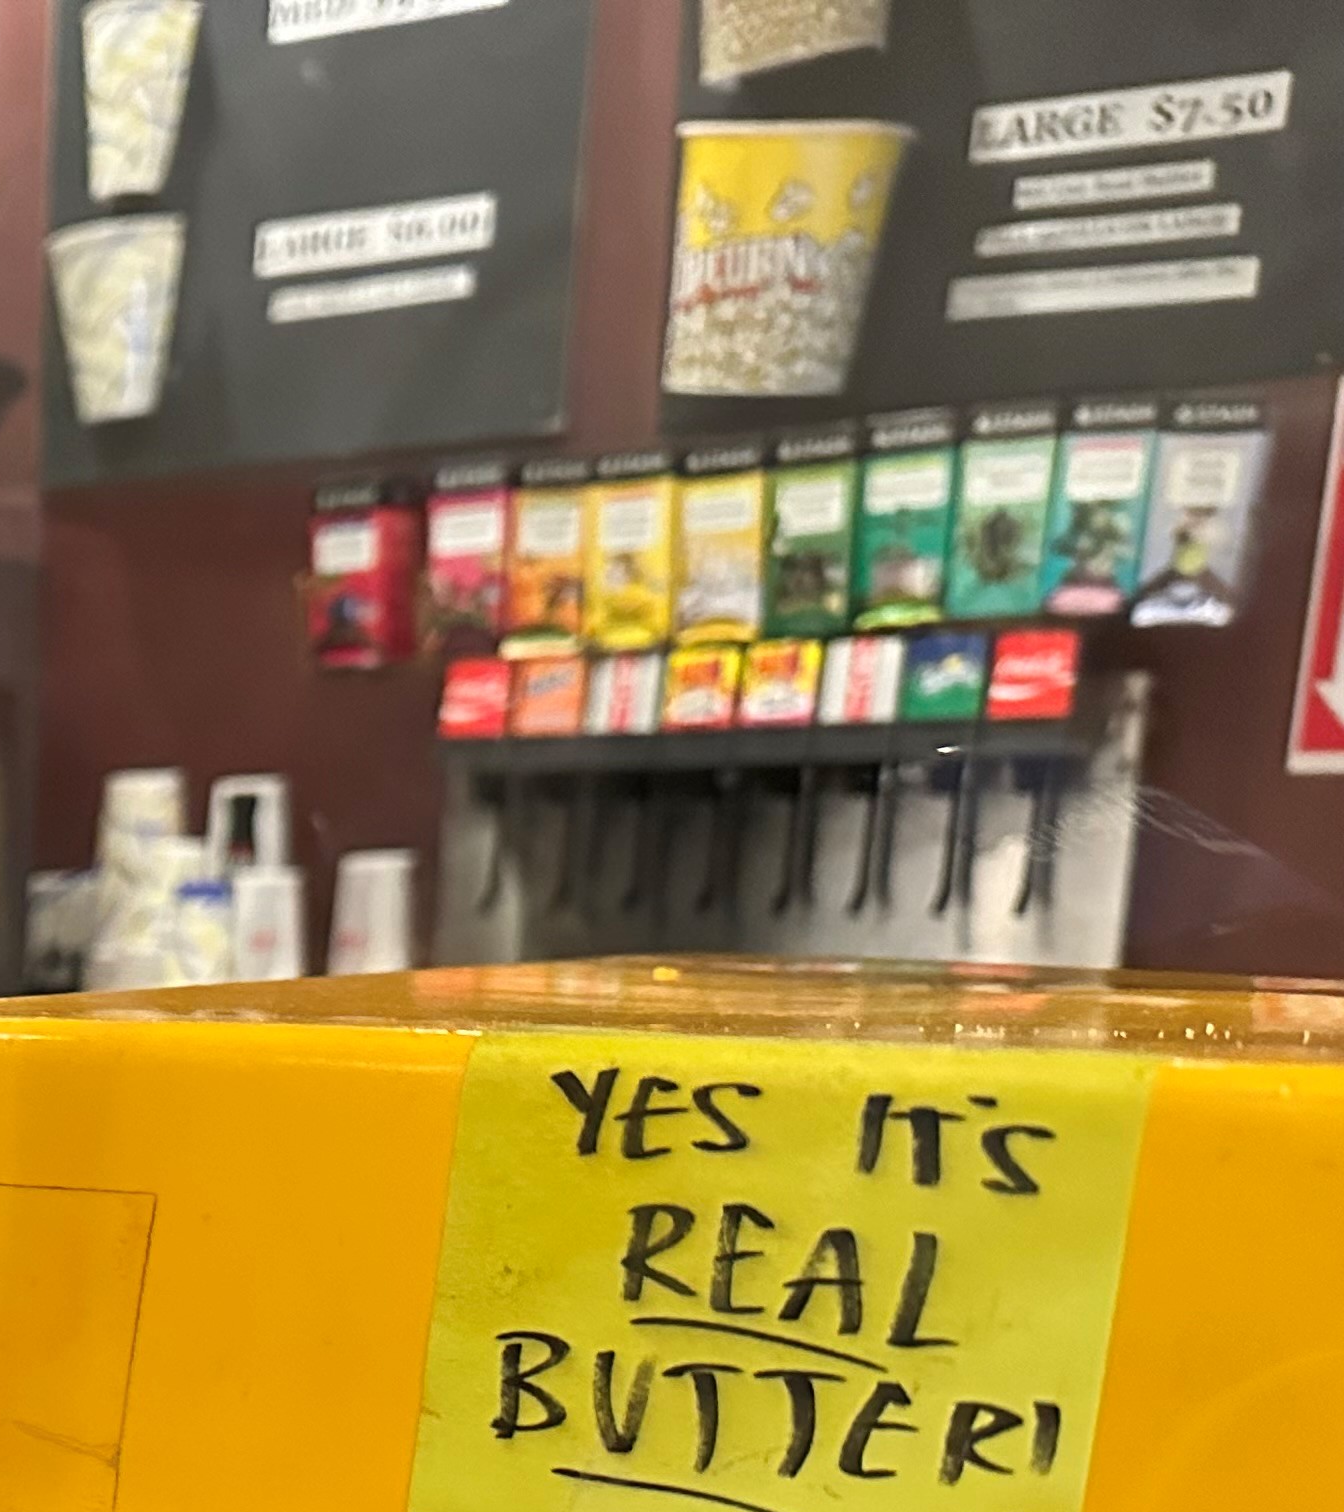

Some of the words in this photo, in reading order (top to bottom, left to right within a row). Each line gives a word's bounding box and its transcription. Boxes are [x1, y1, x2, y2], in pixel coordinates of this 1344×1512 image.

[976, 103, 1123, 149] LARGE
[1147, 89, 1274, 134] $7.50
[551, 1067, 762, 1160] YES
[855, 1092, 1056, 1195] IT'S
[621, 1203, 959, 1348] REAL
